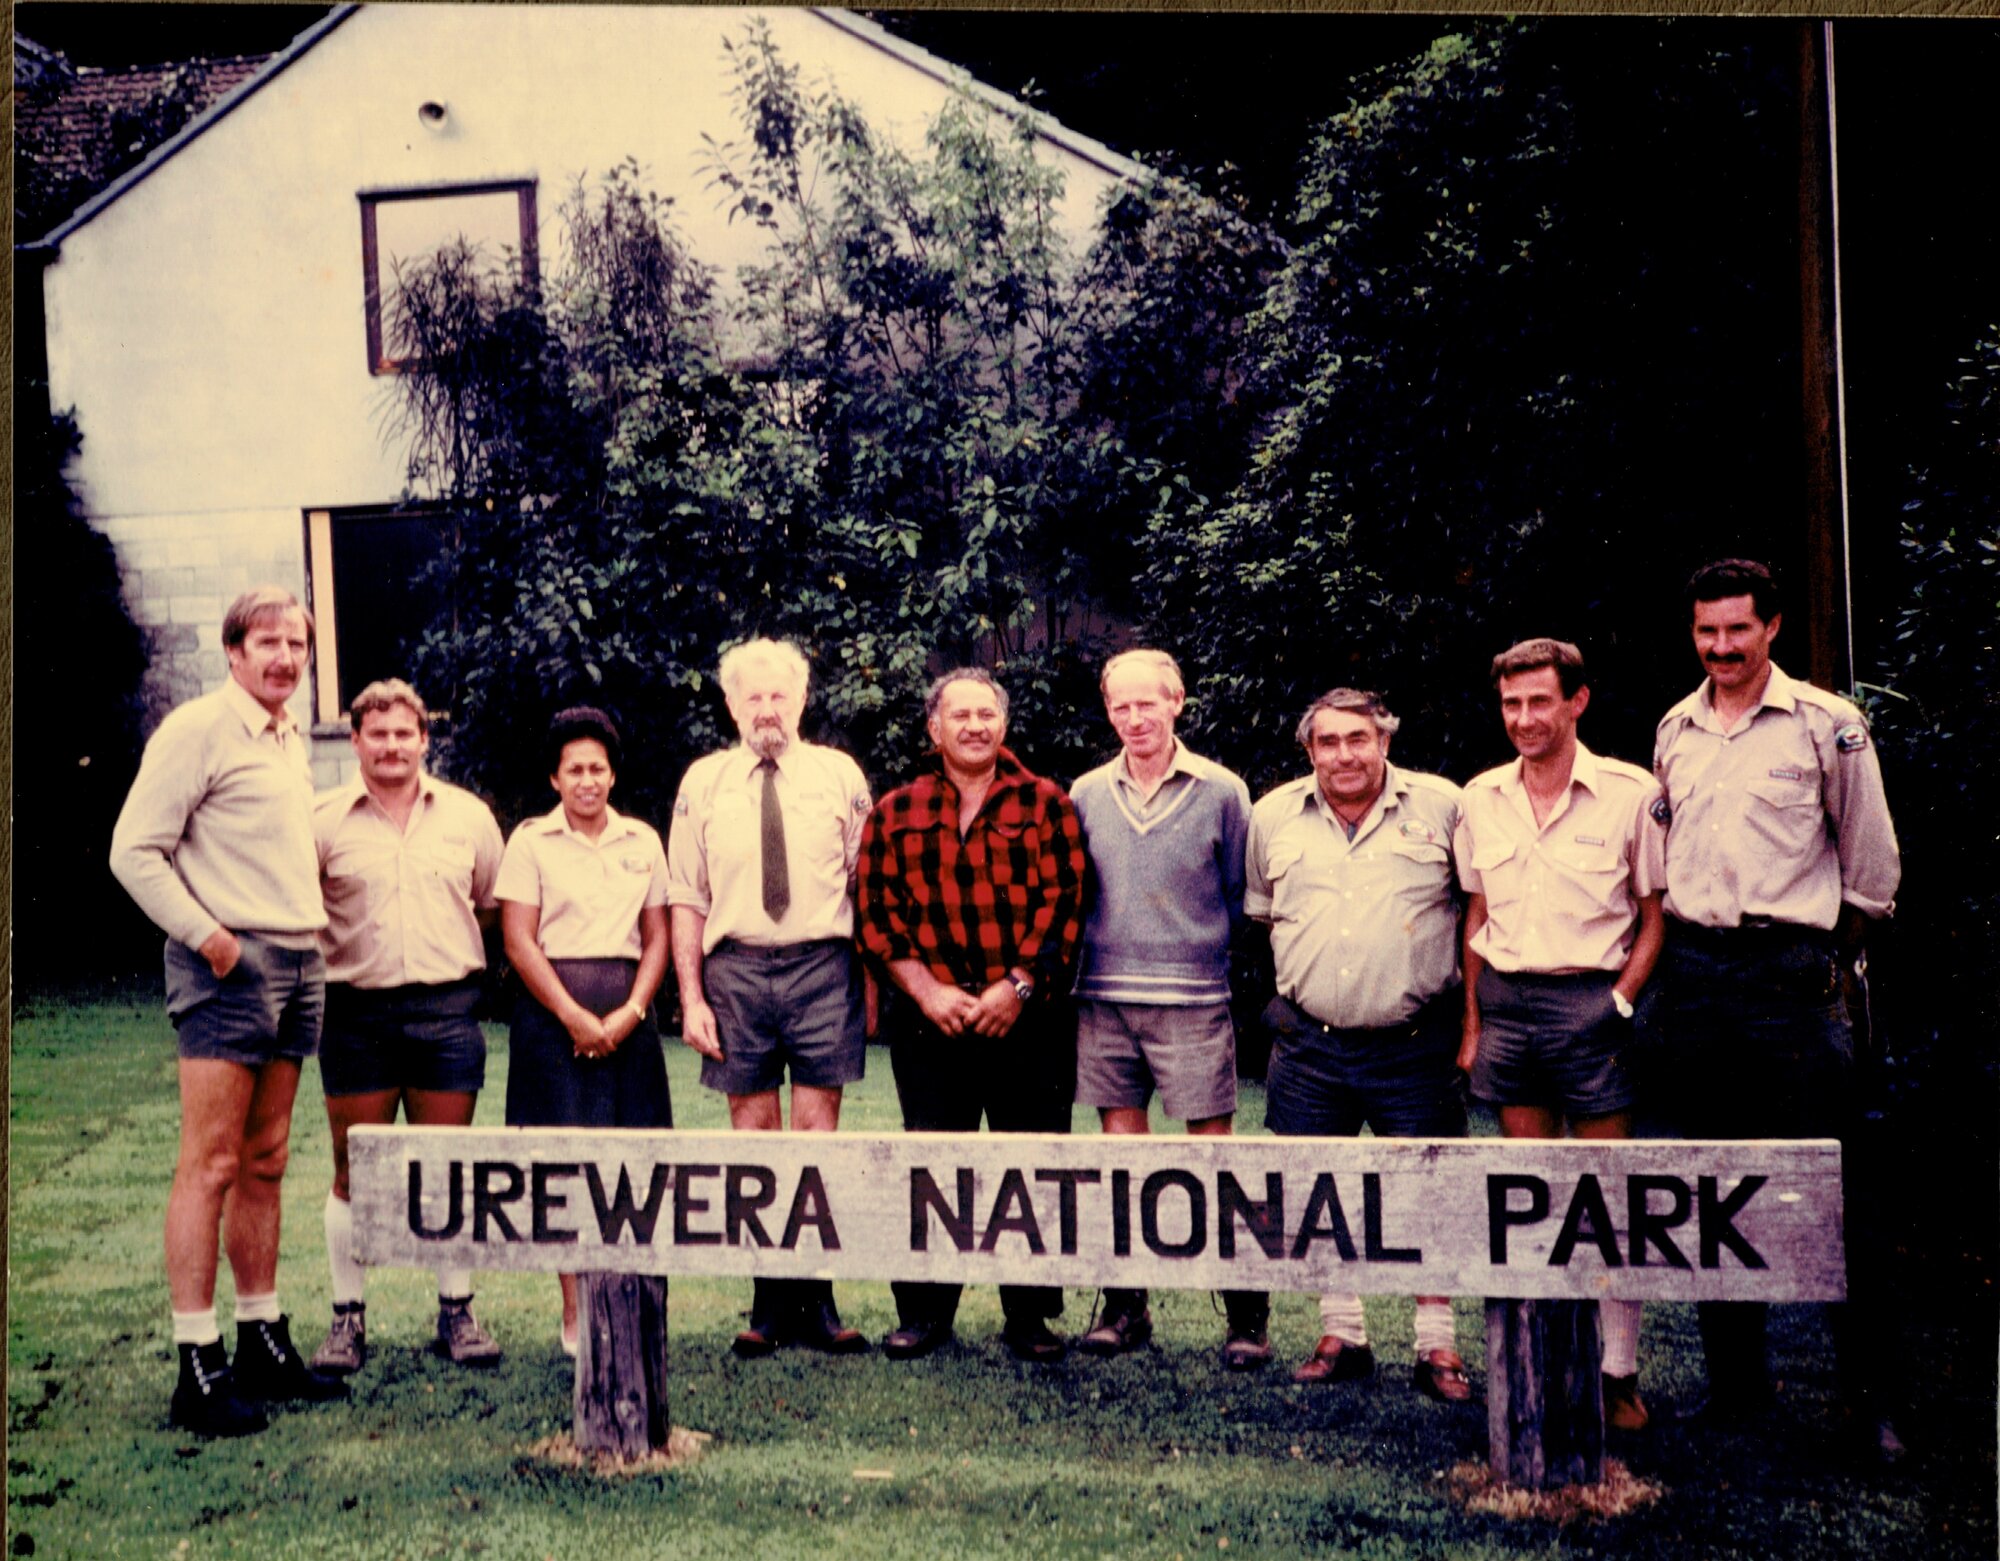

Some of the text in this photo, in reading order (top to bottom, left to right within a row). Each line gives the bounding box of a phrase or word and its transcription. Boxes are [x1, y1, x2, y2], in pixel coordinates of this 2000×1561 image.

[407, 1160, 1769, 1270] UREWERA NATIONAL PARK
